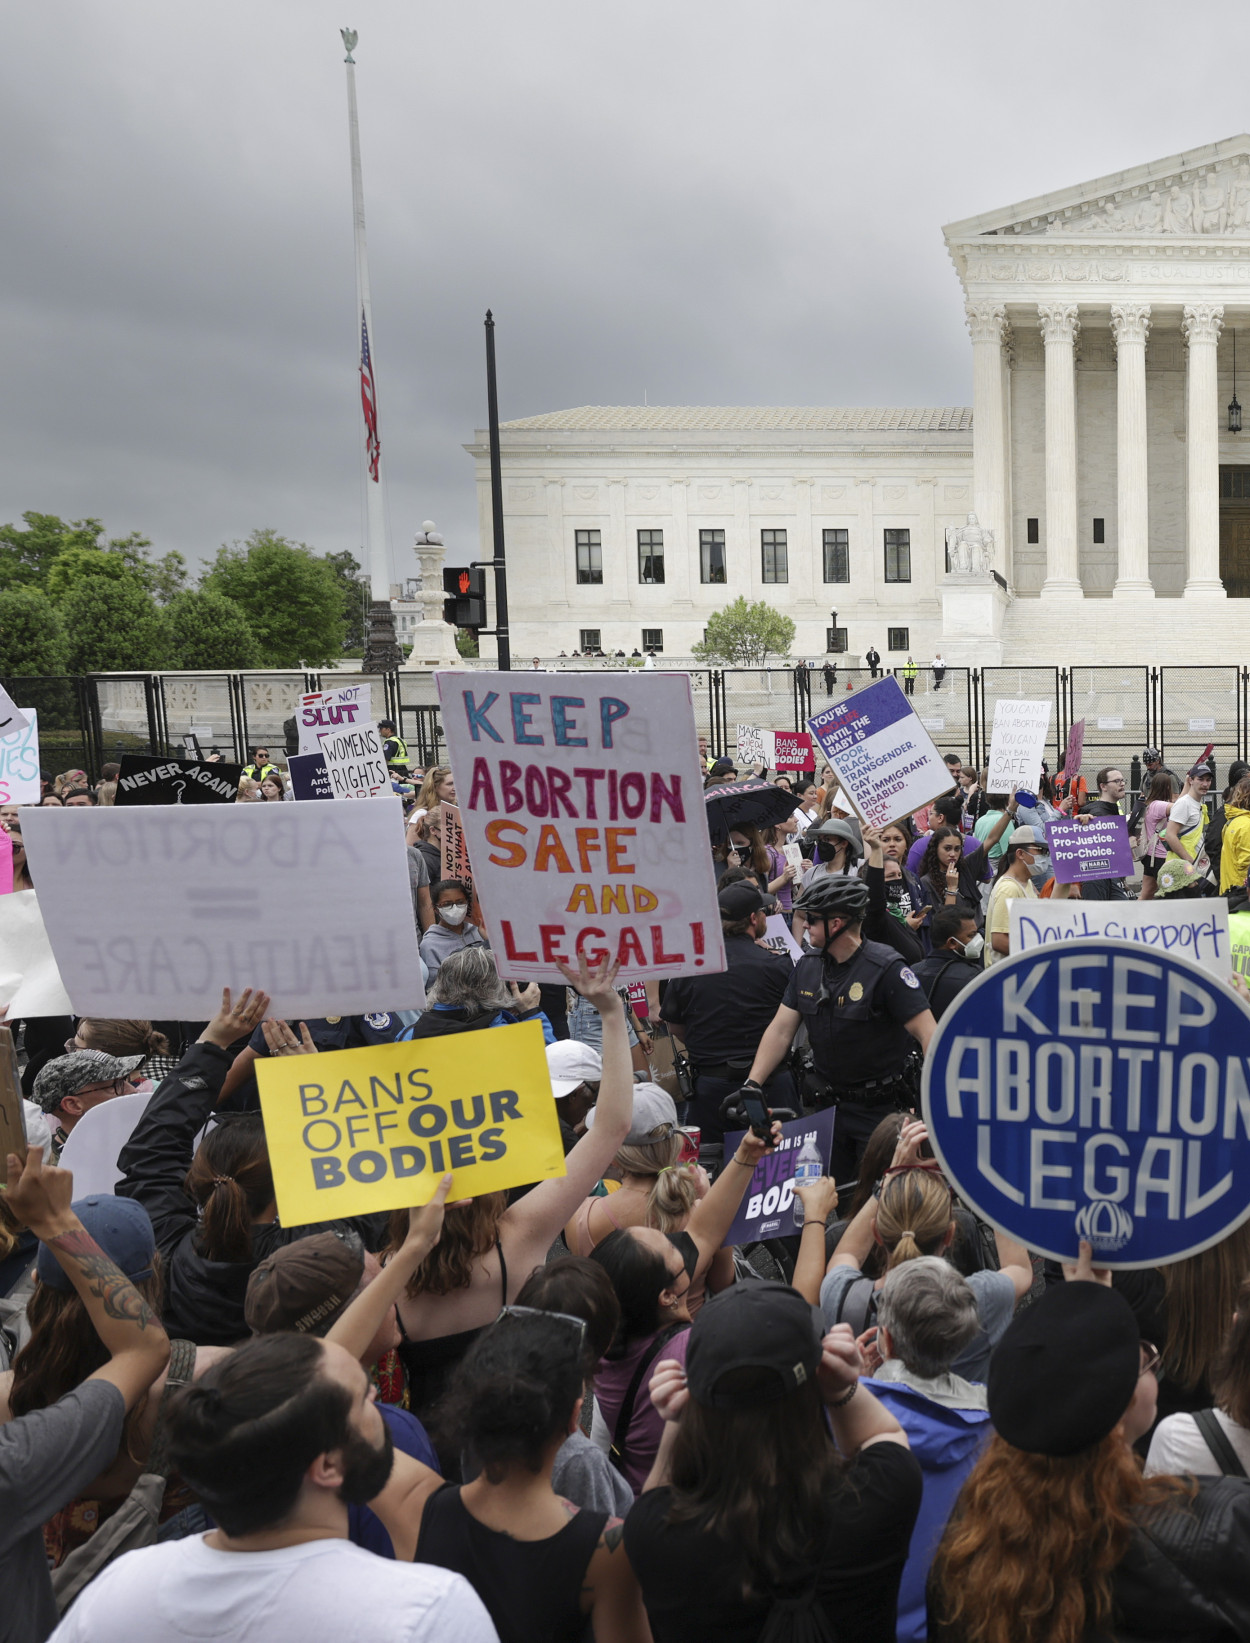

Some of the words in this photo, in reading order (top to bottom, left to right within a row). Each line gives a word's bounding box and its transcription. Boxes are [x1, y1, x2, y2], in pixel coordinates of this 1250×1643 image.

[1140, 265, 1192, 279] EQUAL
[338, 687, 360, 701] NOT
[301, 704, 359, 727] SLUT
[462, 690, 630, 749] KEEP
[811, 703, 849, 729] YOU'RE
[1000, 703, 1021, 715] YOU
[817, 710, 860, 737] PRO-LIFE
[821, 726, 852, 747] UNTIL
[850, 714, 871, 731] THE
[993, 719, 1010, 729] BAN
[1012, 719, 1048, 729] ABORTION
[323, 730, 379, 763] WOMENS
[776, 738, 798, 748] BANS
[827, 738, 855, 757] BABY
[855, 730, 866, 742] IS
[1001, 734, 1019, 745] YOU
[1018, 735, 1038, 745] CAN
[790, 748, 809, 757] OUR
[834, 745, 868, 767] POOR.
[839, 752, 875, 776] BLACK.
[994, 748, 1013, 757] ONLY
[1014, 749, 1030, 757] BAN
[331, 760, 386, 794] RIGHTS
[993, 757, 1031, 774] SAFE
[119, 761, 184, 792] NEVER
[184, 765, 238, 800] AGAIN
[467, 757, 686, 823] ABORTION
[850, 776, 875, 793] GAY.
[990, 778, 1034, 789] ABORTION
[856, 788, 872, 802] AN
[860, 781, 909, 811] DISABLED.
[865, 803, 892, 820] SICK.
[870, 814, 893, 829] ETC.
[1050, 821, 1119, 835] Pro-Freedom.
[485, 819, 637, 874] SAFE
[1053, 833, 1116, 848] Pro-Justice.
[1055, 846, 1116, 861] Pro-Choice.
[565, 883, 659, 915] AND
[500, 919, 705, 967] LEGAL!
[1002, 953, 1218, 1046] KEEP
[298, 1067, 433, 1117] BANS
[302, 1110, 399, 1153] OFF
[407, 1089, 524, 1138] OUR
[793, 1135, 802, 1148] IS
[310, 1128, 507, 1190] BODIES
[977, 1124, 1234, 1221] LEGAL
[745, 1177, 796, 1220] BOD
[1074, 1199, 1134, 1240] NOW
